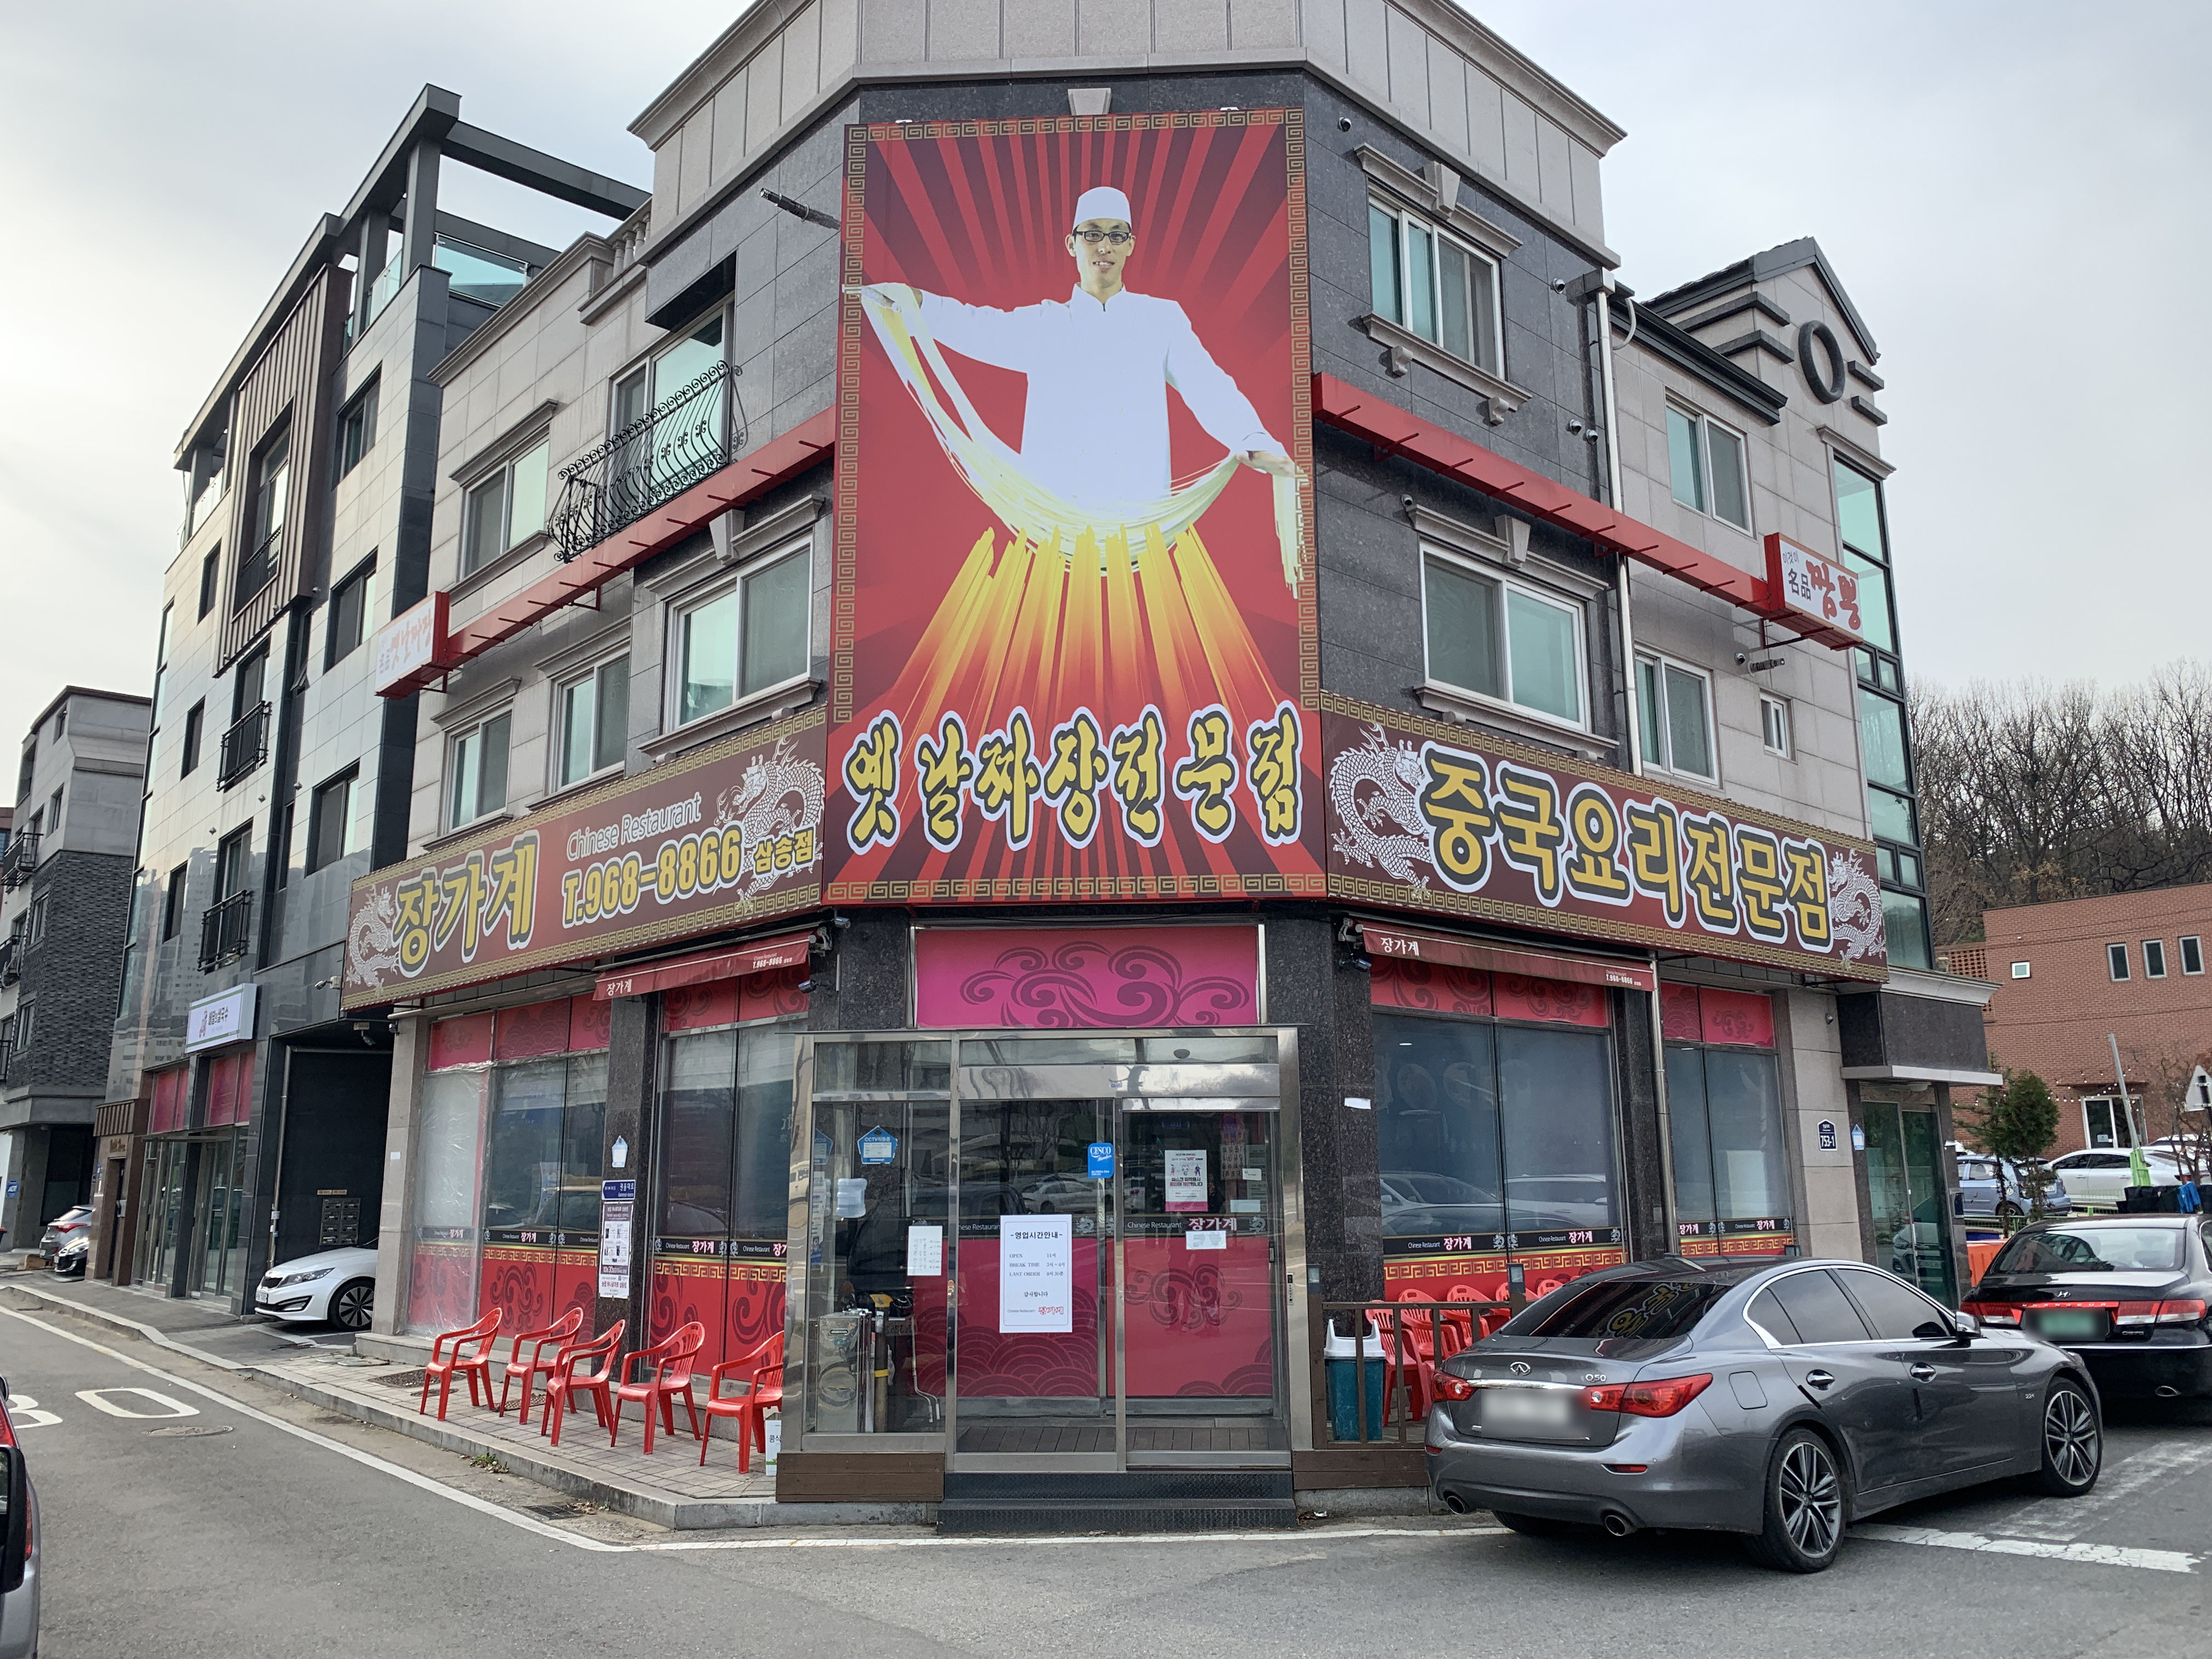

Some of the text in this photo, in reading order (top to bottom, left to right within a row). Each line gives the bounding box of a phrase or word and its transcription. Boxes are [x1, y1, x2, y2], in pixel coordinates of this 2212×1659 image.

[1782, 550, 1799, 565] 이것이
[1787, 568, 1812, 601] 名品
[1805, 560, 1861, 630] 짬뽕
[843, 700, 1304, 855] 옛날짜장전문점
[567, 792, 702, 862] Chinese Restaurant
[1415, 741, 1833, 952] 중국요리전문점
[562, 820, 816, 929] T.968-8866 삼송점
[393, 830, 540, 978] 장가계
[1381, 936, 1420, 956] 장가계
[607, 979, 632, 996] 장가계
[1820, 1135, 1835, 1147] 753-1
[1090, 1146, 1111, 1155] CESCO
[1188, 1217, 1237, 1232] 장가계
[1679, 1223, 1699, 1235] 장가계
[1757, 1219, 1775, 1231] 장가계
[521, 1232, 537, 1243] 장가계
[1443, 1237, 1472, 1251] 장가계
[1568, 1231, 1593, 1244] 장가계
[692, 1240, 714, 1254] 장가계
[1039, 1306, 1064, 1315] 장가계
[1585, 1374, 1606, 1383] Q50
